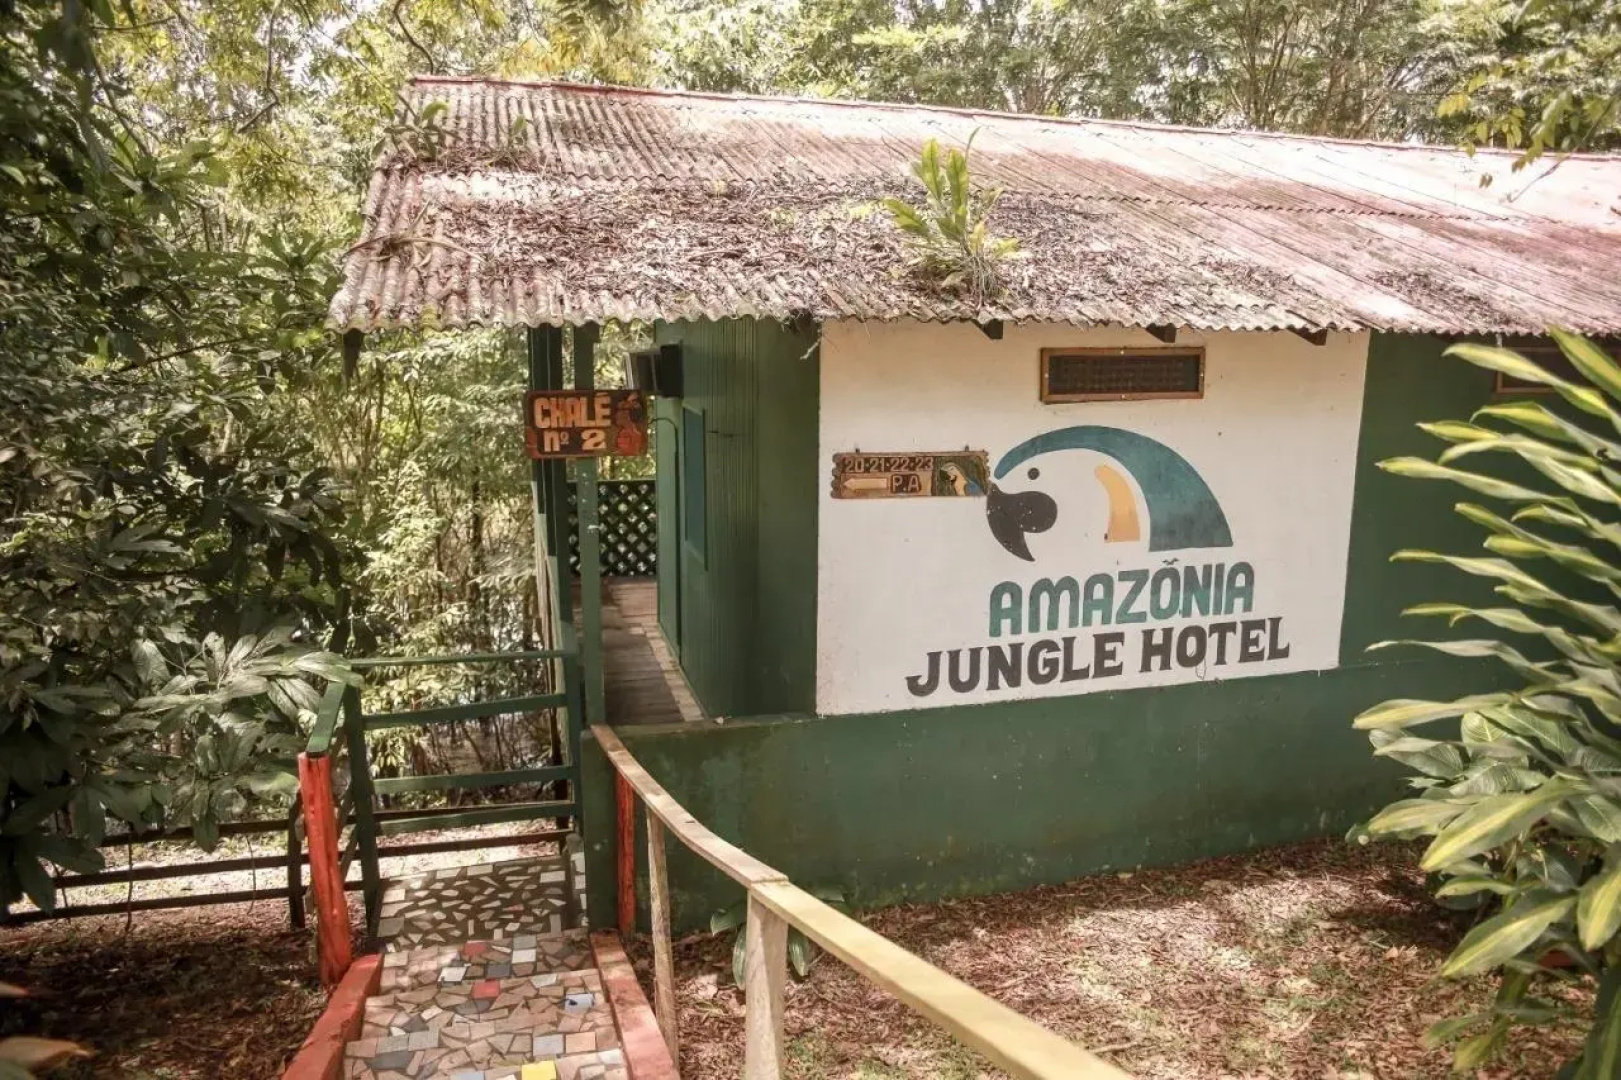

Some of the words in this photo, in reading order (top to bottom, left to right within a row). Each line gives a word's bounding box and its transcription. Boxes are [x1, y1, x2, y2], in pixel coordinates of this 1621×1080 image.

[534, 392, 612, 428] CHALÉ
[580, 428, 607, 451] 2
[905, 630, 1125, 696] JUNGLE
[1139, 616, 1291, 674] HOTEL
